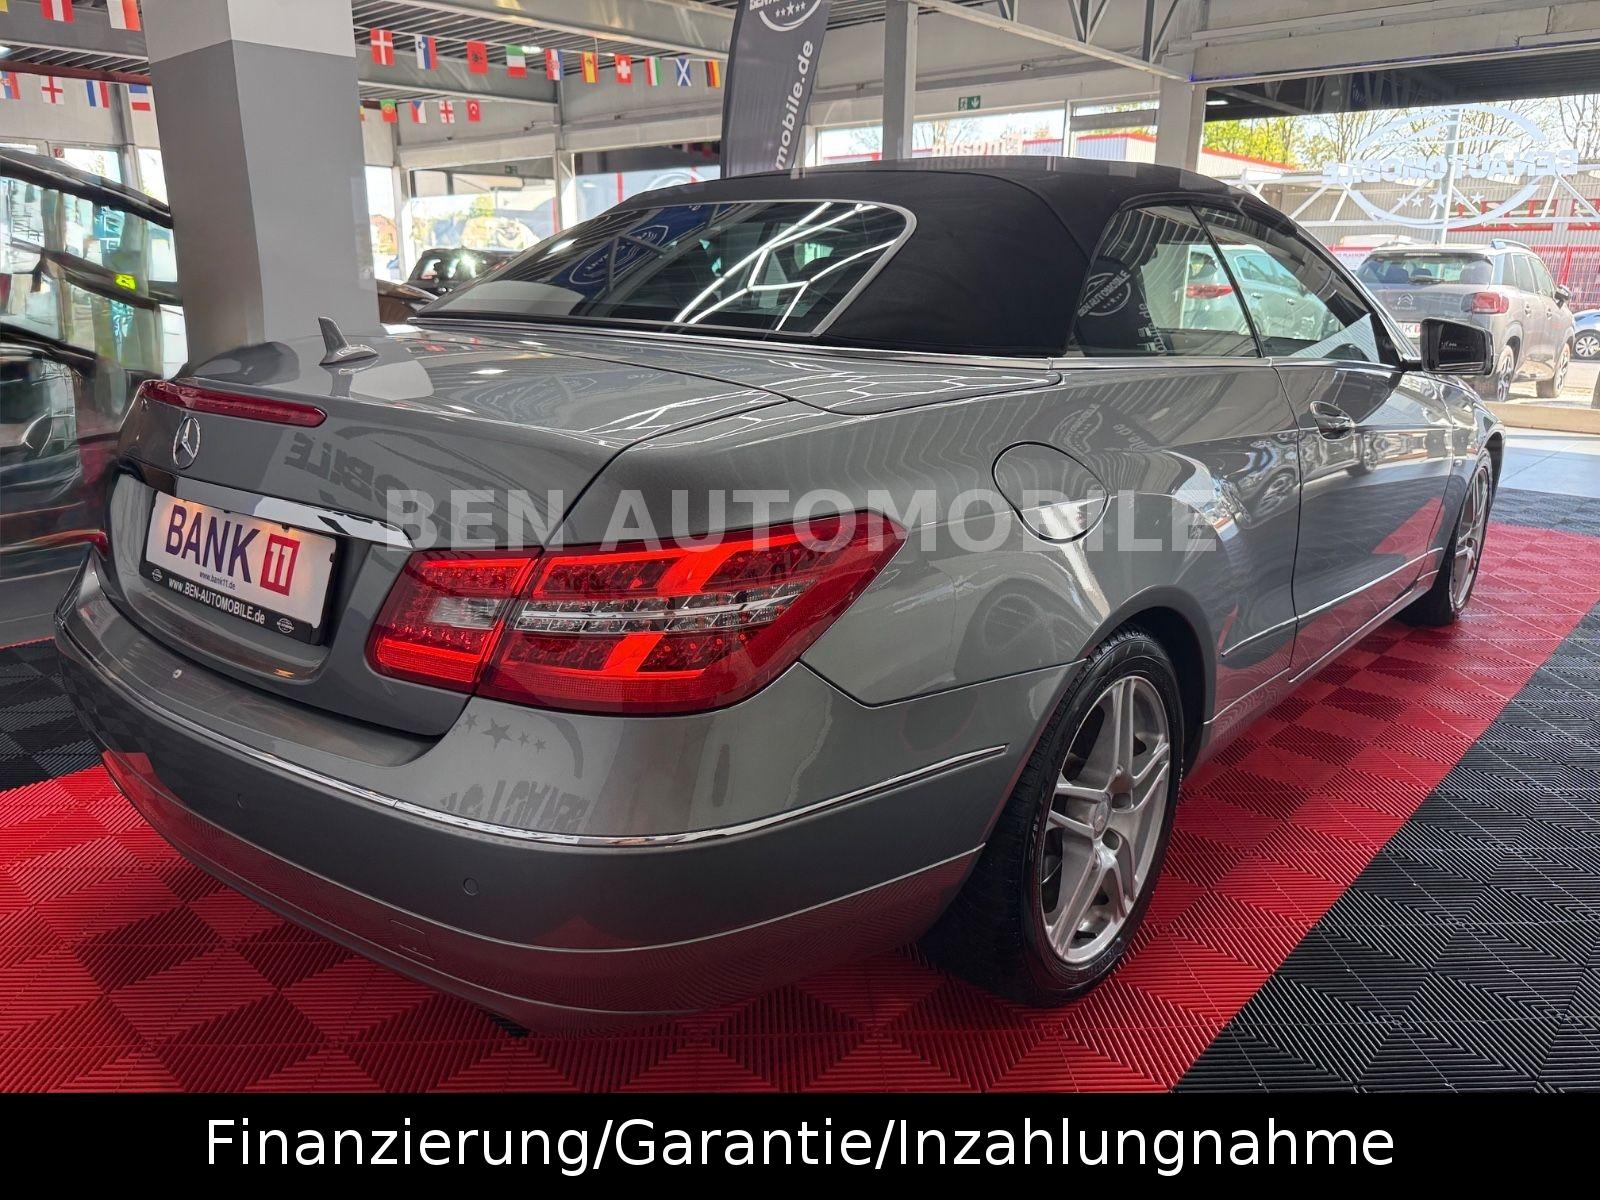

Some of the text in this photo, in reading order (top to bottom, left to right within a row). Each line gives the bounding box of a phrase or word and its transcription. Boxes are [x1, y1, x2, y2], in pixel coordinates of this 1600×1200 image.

[775, 40, 814, 171] mobile.de
[165, 504, 295, 589] BANK 11
[168, 577, 265, 625] www.BEN-AUTOMOBILE.de
